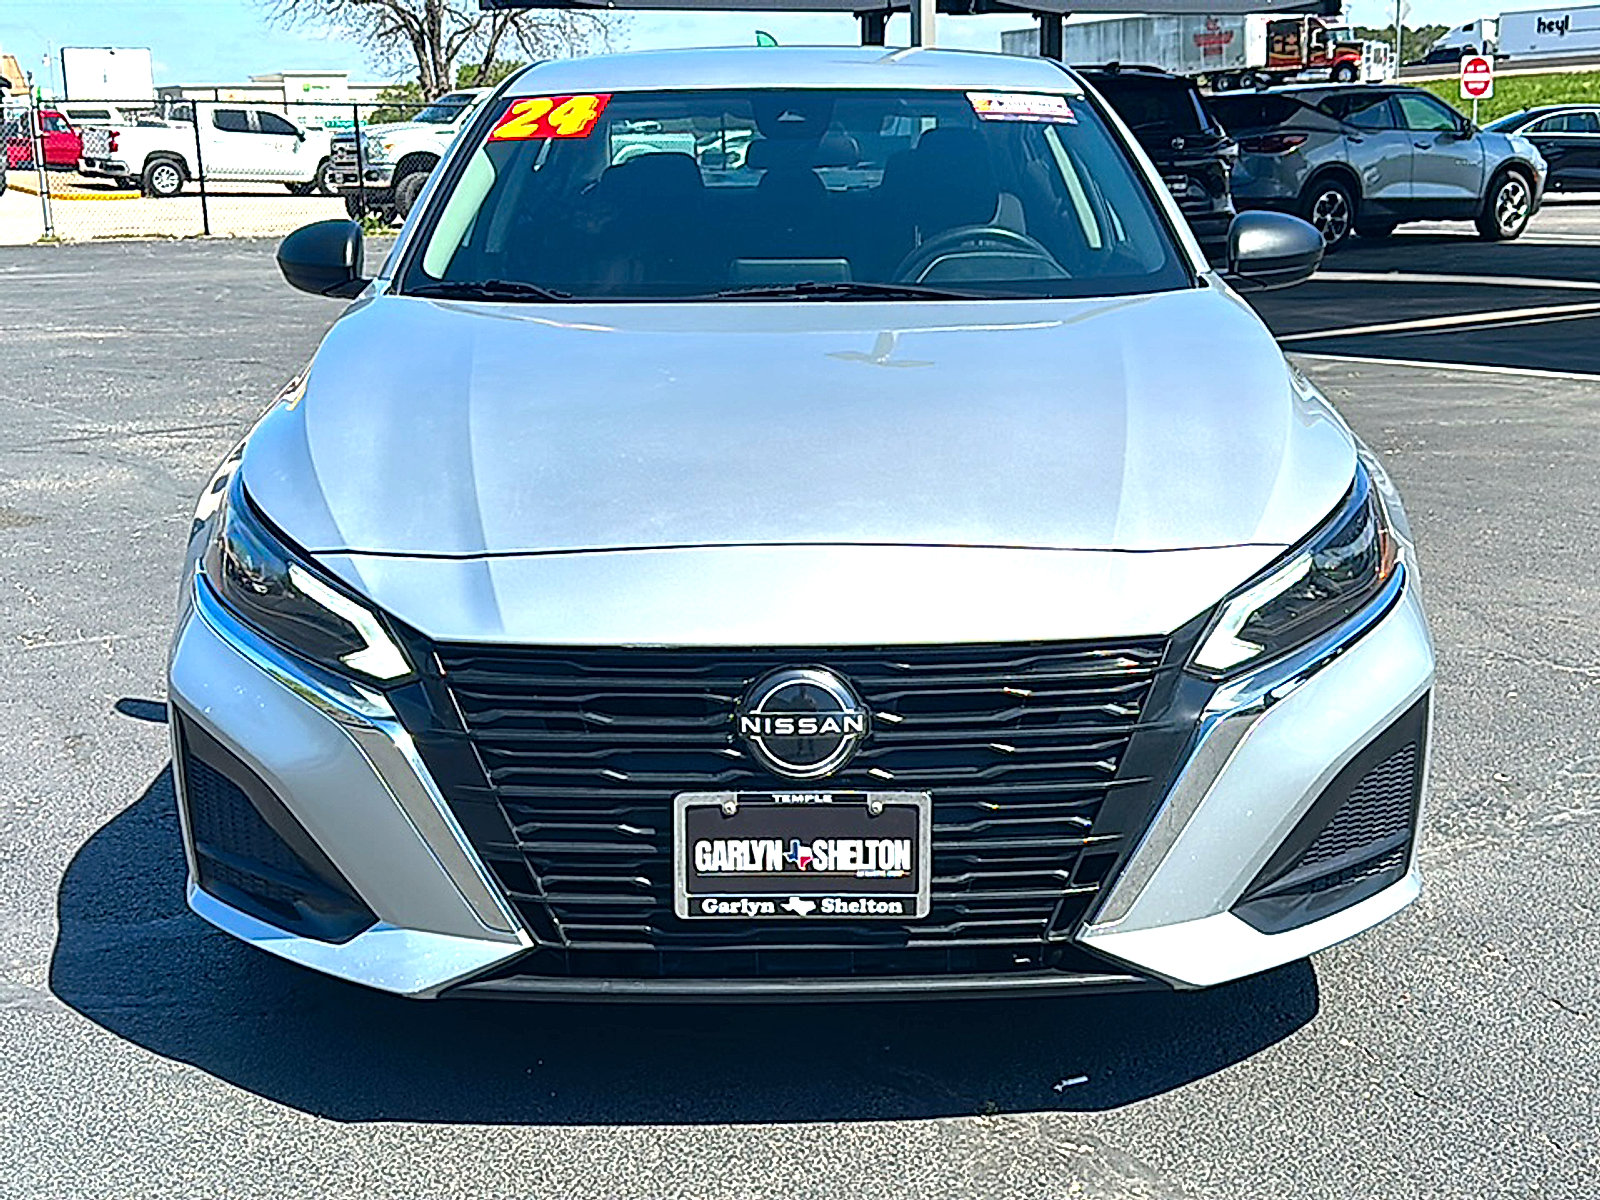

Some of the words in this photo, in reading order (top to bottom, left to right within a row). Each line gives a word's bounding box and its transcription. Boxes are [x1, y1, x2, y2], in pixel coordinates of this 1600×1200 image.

[1536, 14, 1570, 37] heyl
[493, 95, 600, 138] 24
[741, 715, 864, 735] NISSAN
[771, 794, 833, 804] TEMPLE
[694, 839, 783, 872] GARLYN
[812, 839, 912, 872] SHELTON
[701, 898, 775, 917] Garlyn
[820, 898, 903, 915] Shelton
